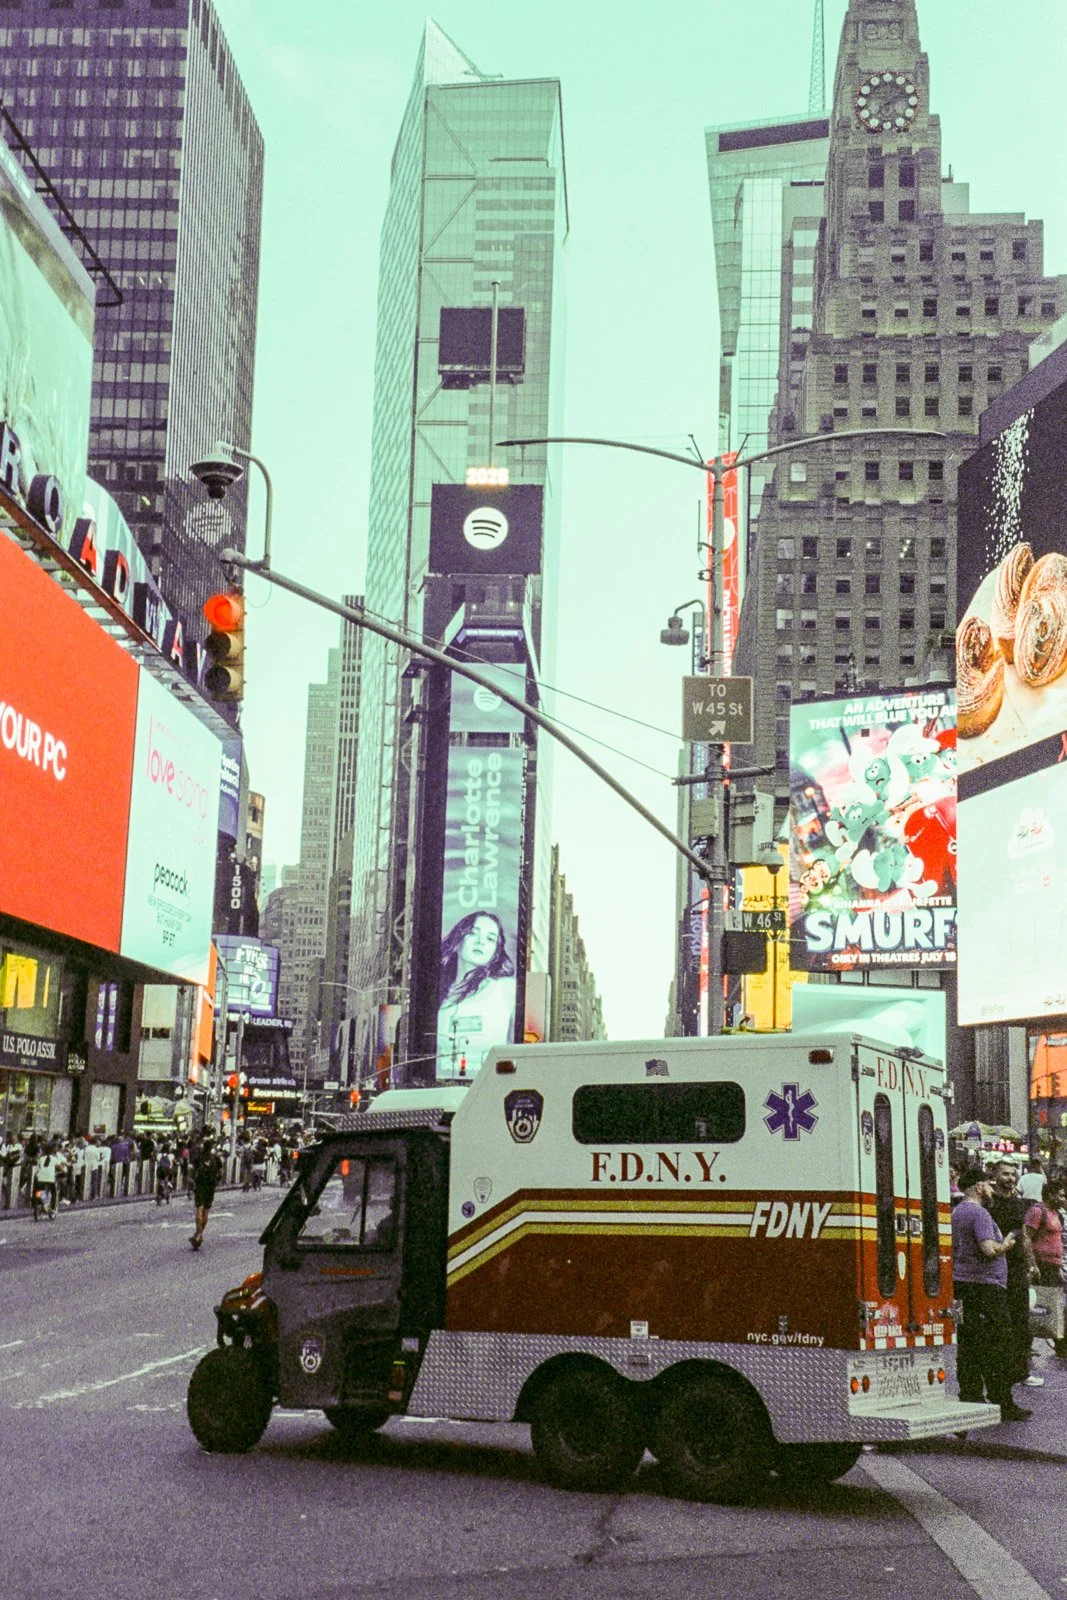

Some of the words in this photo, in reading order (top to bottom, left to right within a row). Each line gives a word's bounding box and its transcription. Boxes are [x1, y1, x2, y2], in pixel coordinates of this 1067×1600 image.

[708, 684, 727, 697] TO
[843, 701, 863, 715] AN
[865, 692, 946, 713] ADVENTURE
[692, 702, 704, 715] W
[705, 702, 726, 716] 45
[728, 702, 743, 716] St
[809, 717, 841, 731] THAT
[842, 712, 874, 728] WILL
[875, 709, 908, 723] BLUE
[908, 705, 939, 720] YOU
[43, 731, 68, 781] PC
[458, 758, 483, 909] Charlotte
[478, 752, 502, 908] Lawrence
[153, 862, 188, 897] peacock
[230, 864, 242, 909] 1500
[743, 912, 753, 929] W
[756, 912, 772, 929] 46
[804, 907, 958, 952] SMURF
[831, 953, 859, 964] ONLY
[859, 953, 871, 963] IN
[871, 952, 921, 964] THEATRES
[920, 951, 943, 965] JULY
[3, 1035, 15, 1053] U.S.
[16, 1037, 37, 1057] POLO
[590, 1151, 727, 1183] F.D.N.Y.
[749, 1201, 832, 1239] FDNY
[747, 1332, 825, 1348] nyc.gov/fdny
